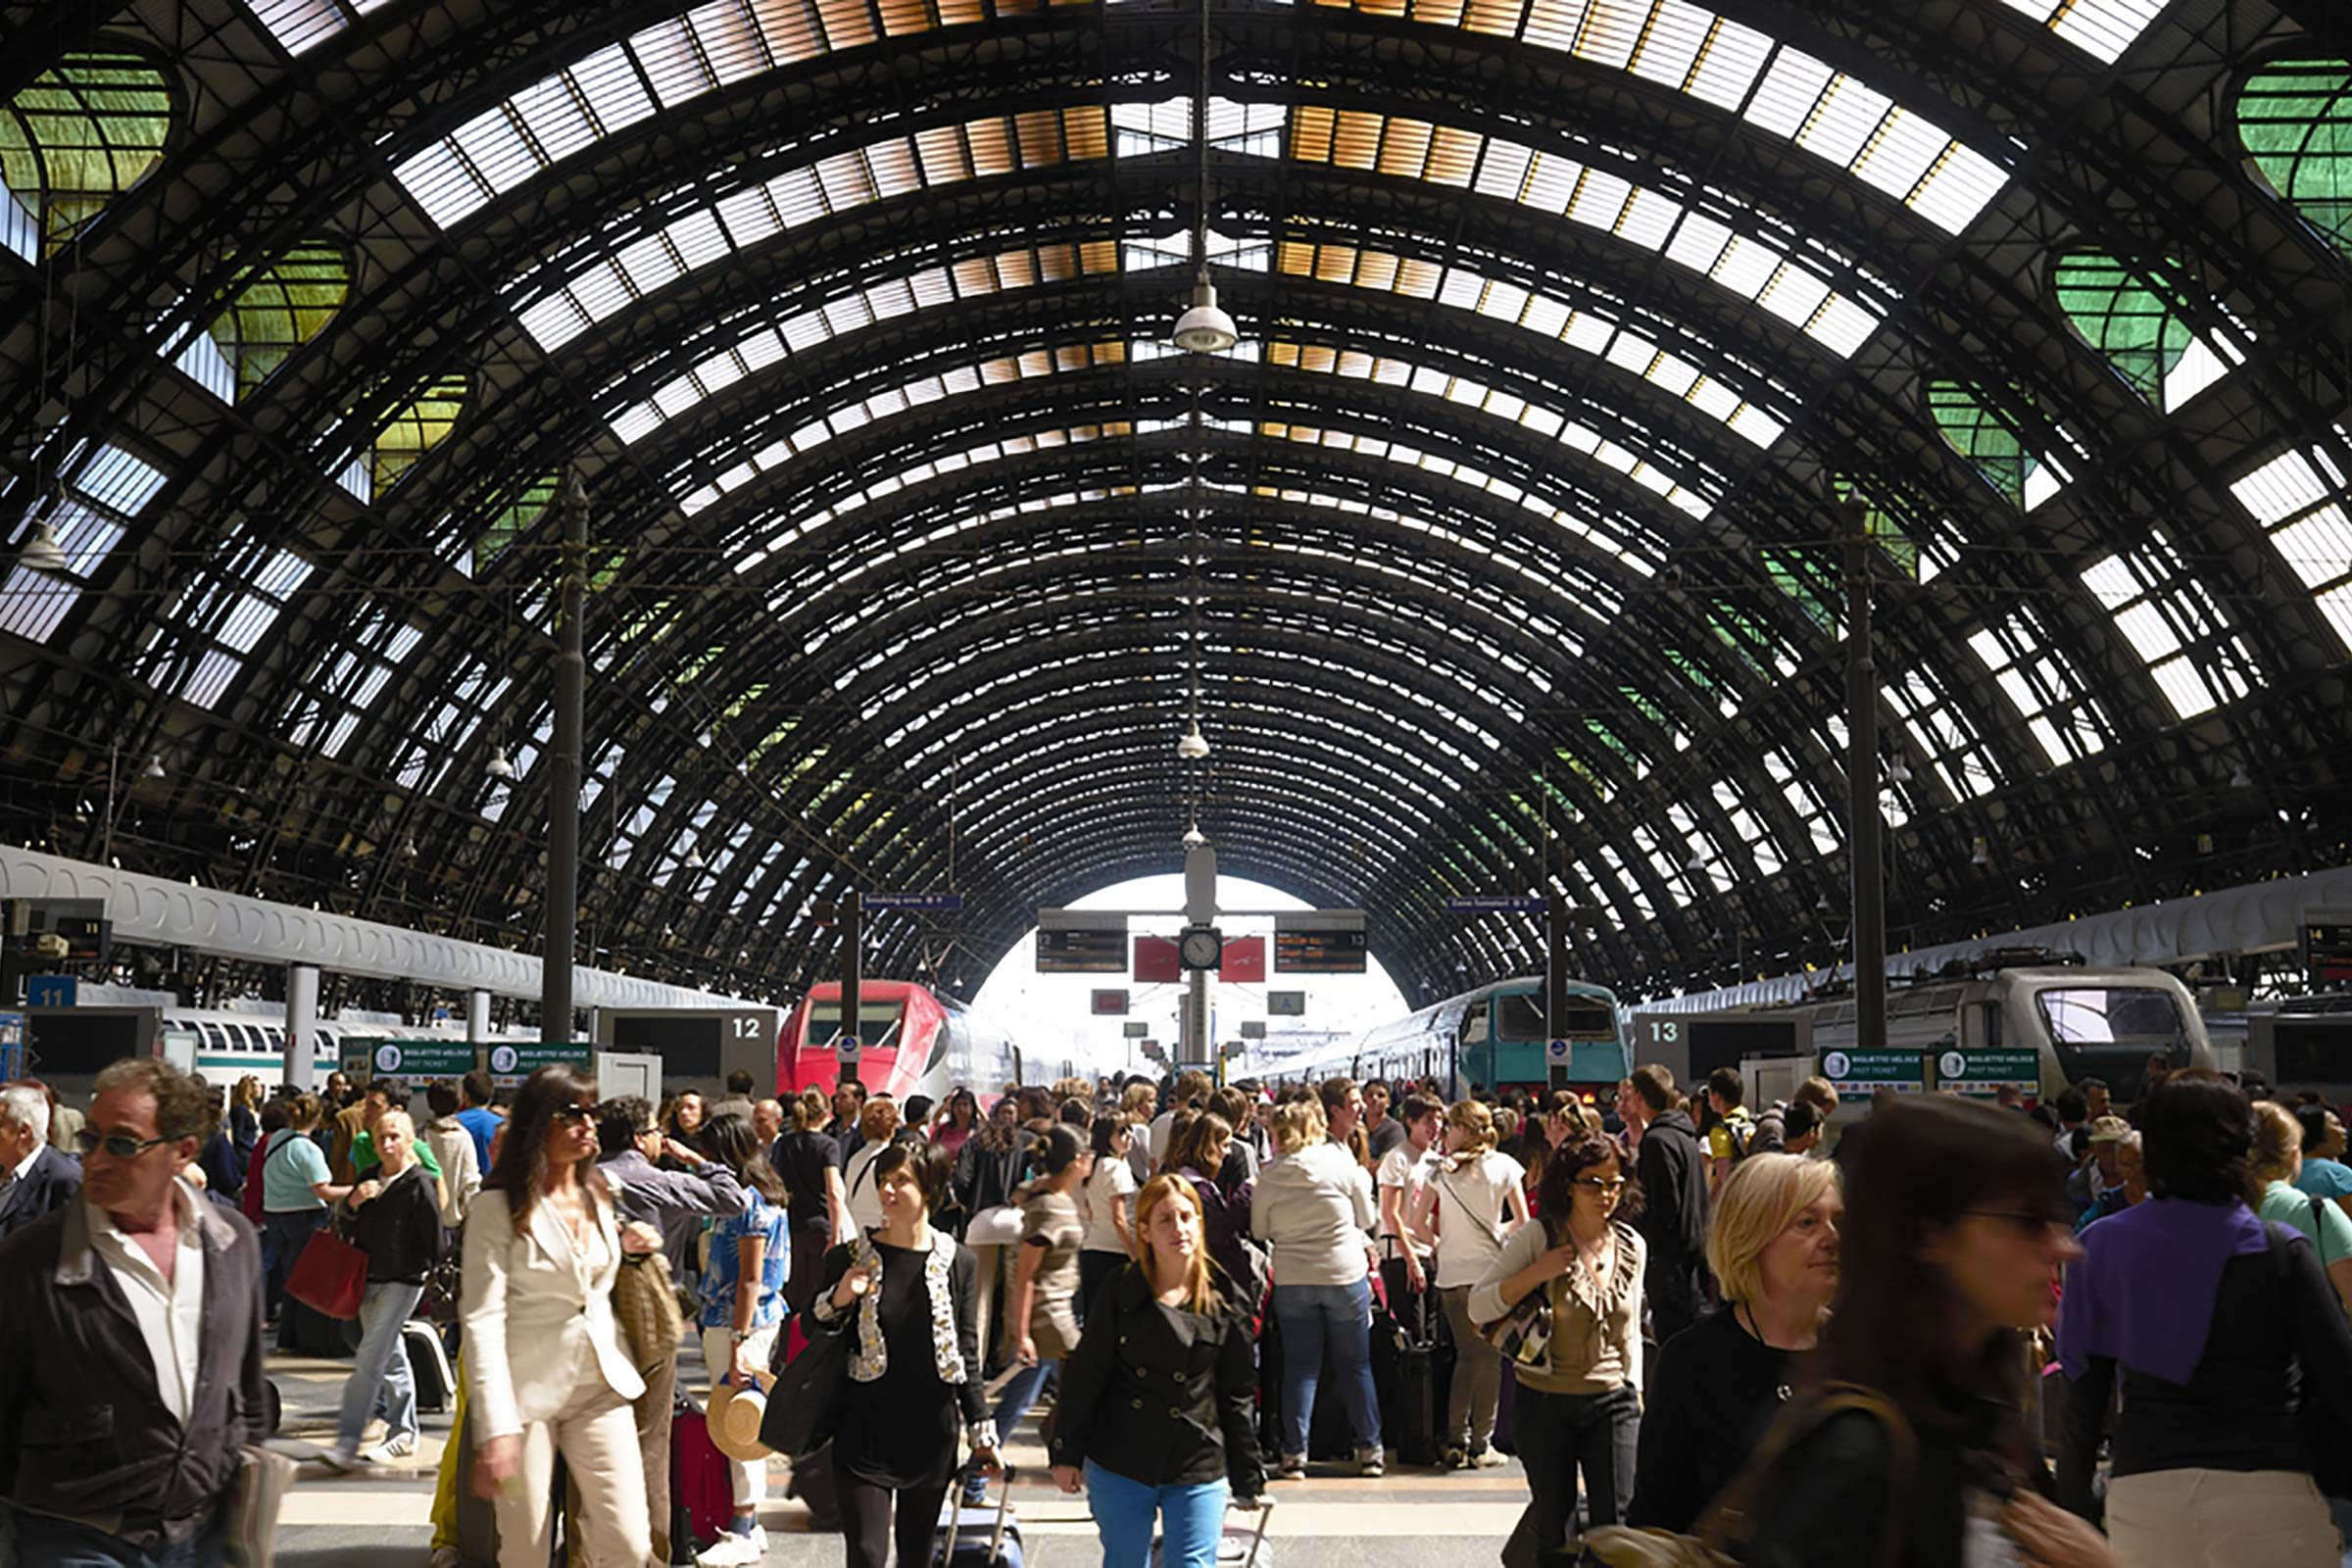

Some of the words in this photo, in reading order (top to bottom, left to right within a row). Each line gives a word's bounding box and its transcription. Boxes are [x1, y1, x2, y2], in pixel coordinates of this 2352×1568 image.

[85, 923, 98, 934] 11
[41, 988, 63, 1006] 11
[733, 1018, 760, 1038] 12
[1649, 1022, 1678, 1043] 13
